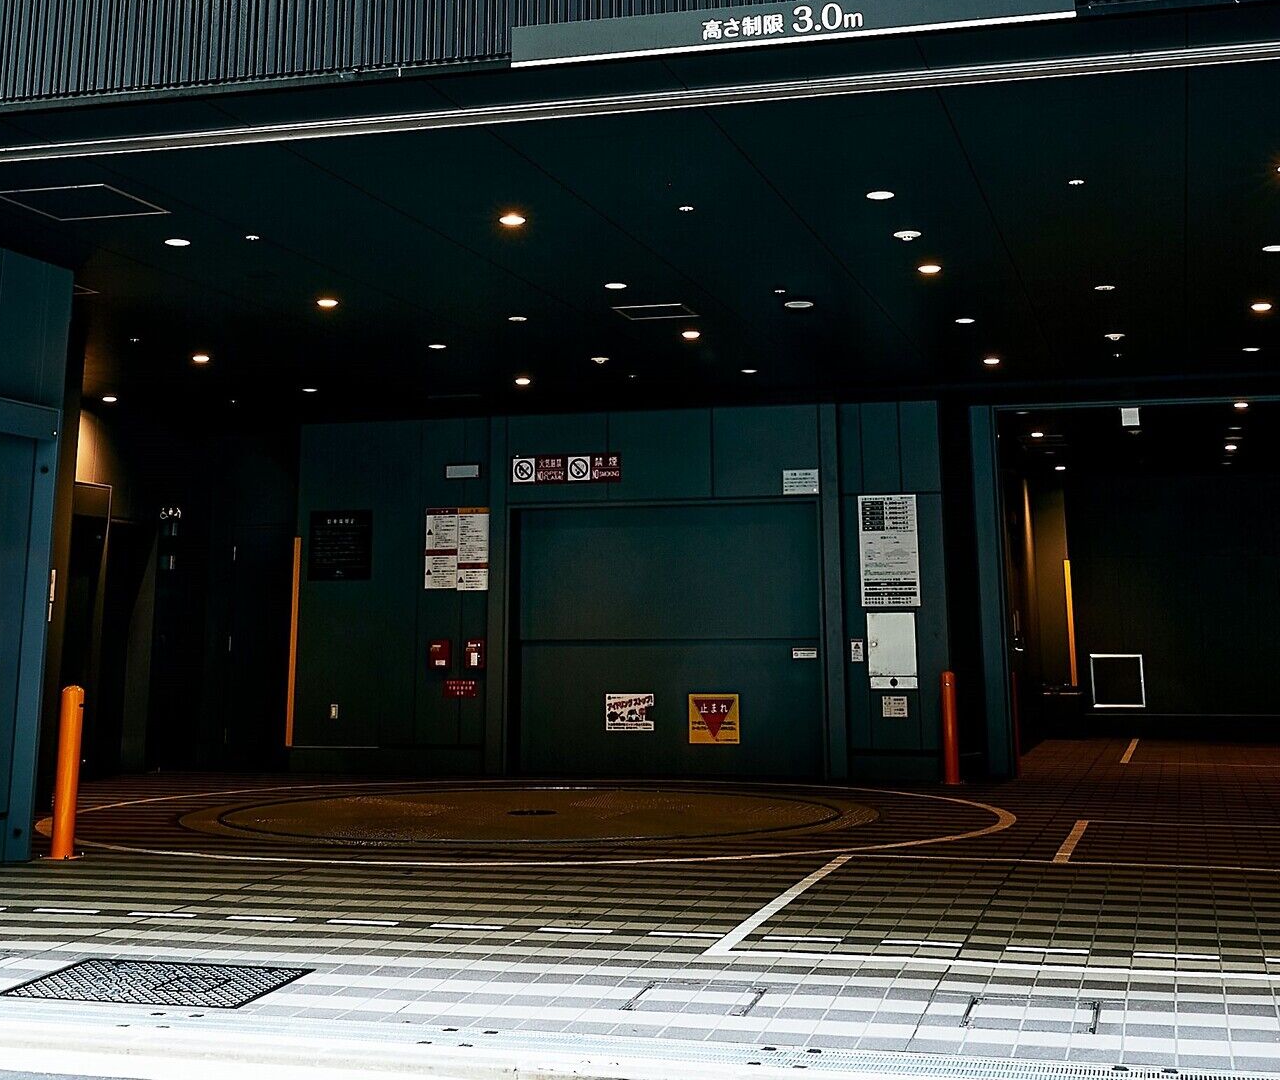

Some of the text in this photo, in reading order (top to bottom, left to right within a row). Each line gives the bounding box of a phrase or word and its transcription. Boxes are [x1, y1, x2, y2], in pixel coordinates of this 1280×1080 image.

[701, 2, 864, 41] 高さ制限 3.0m
[594, 456, 618, 467] 禁煙
[700, 703, 728, 714] 止まれ
